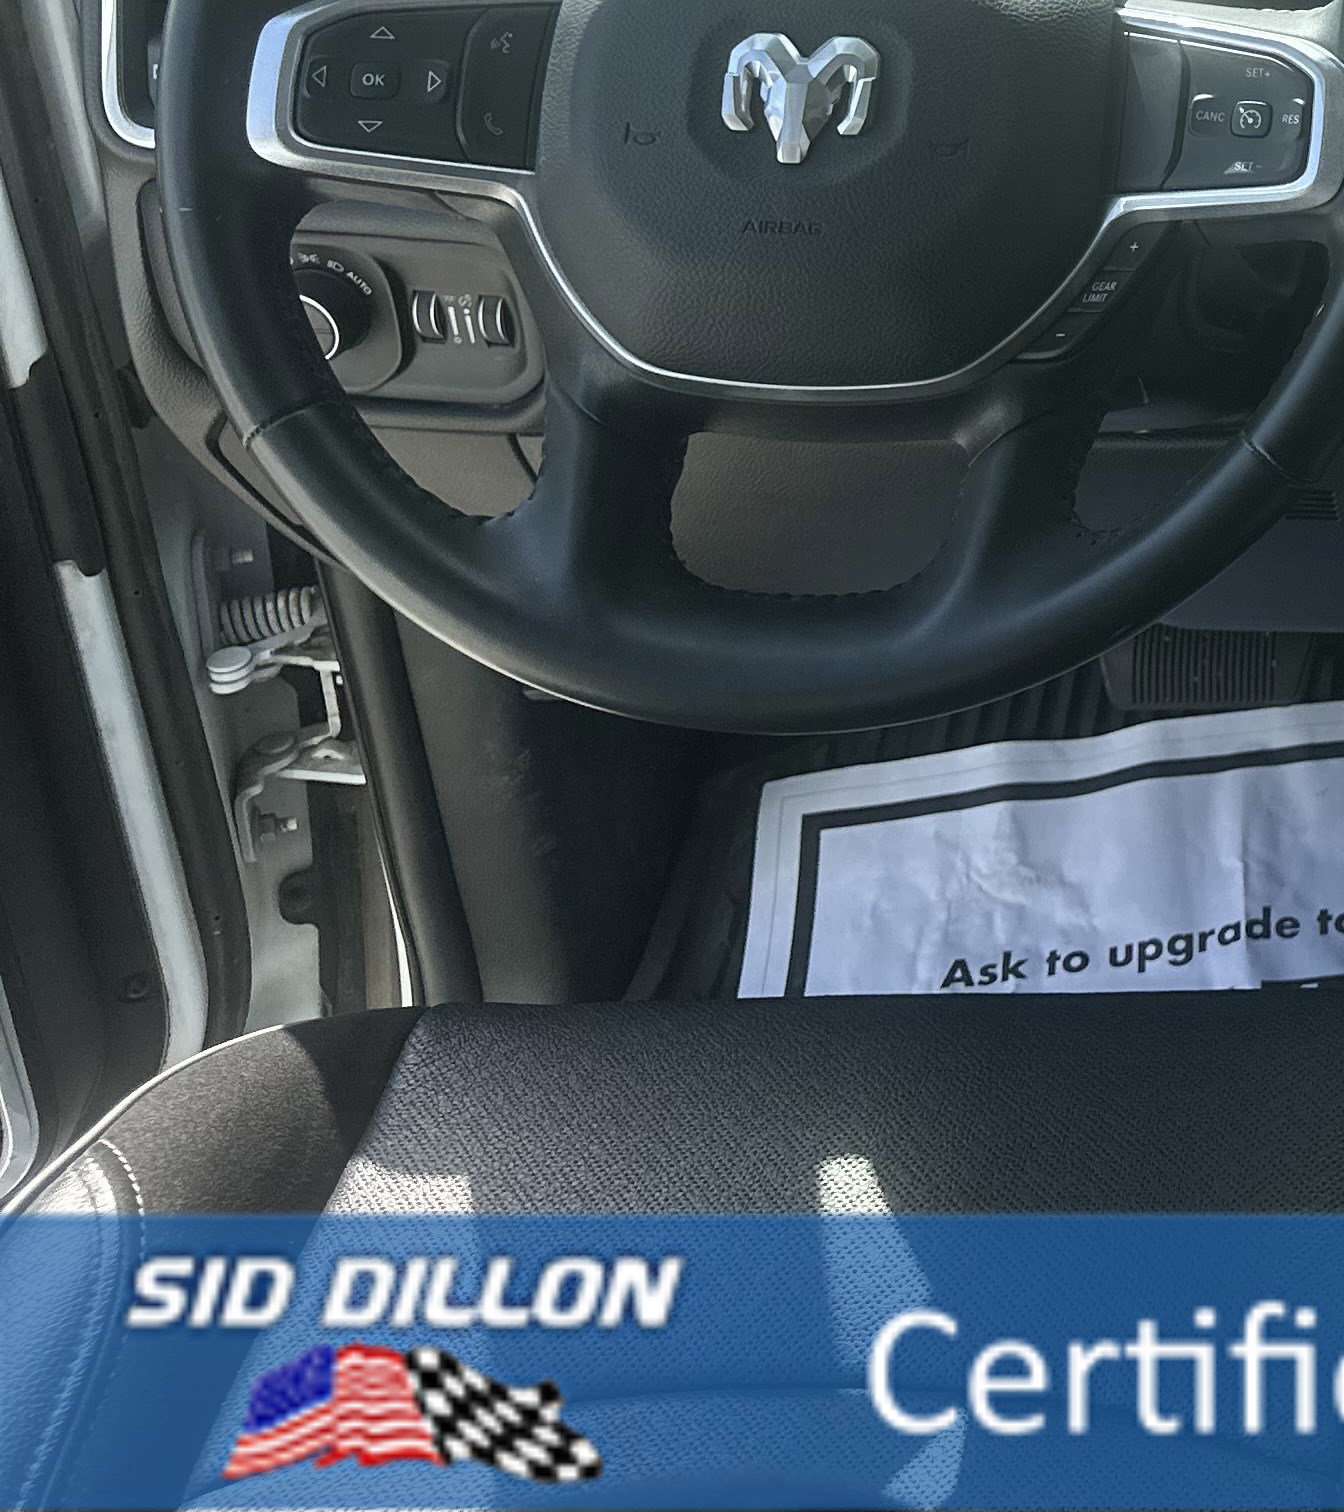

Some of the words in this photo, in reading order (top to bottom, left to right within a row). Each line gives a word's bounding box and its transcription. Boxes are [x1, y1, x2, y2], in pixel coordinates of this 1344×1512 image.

[362, 73, 385, 86] OK
[1196, 110, 1226, 122] CANC
[1282, 113, 1300, 125] RES
[742, 220, 822, 234] AIRBAG
[347, 271, 372, 296] AUTO
[1091, 281, 1118, 292] GEAR
[1083, 292, 1109, 303] LIMIT
[939, 951, 1029, 989] Ask
[1046, 949, 1090, 976] to
[1108, 905, 1301, 974] upgrade
